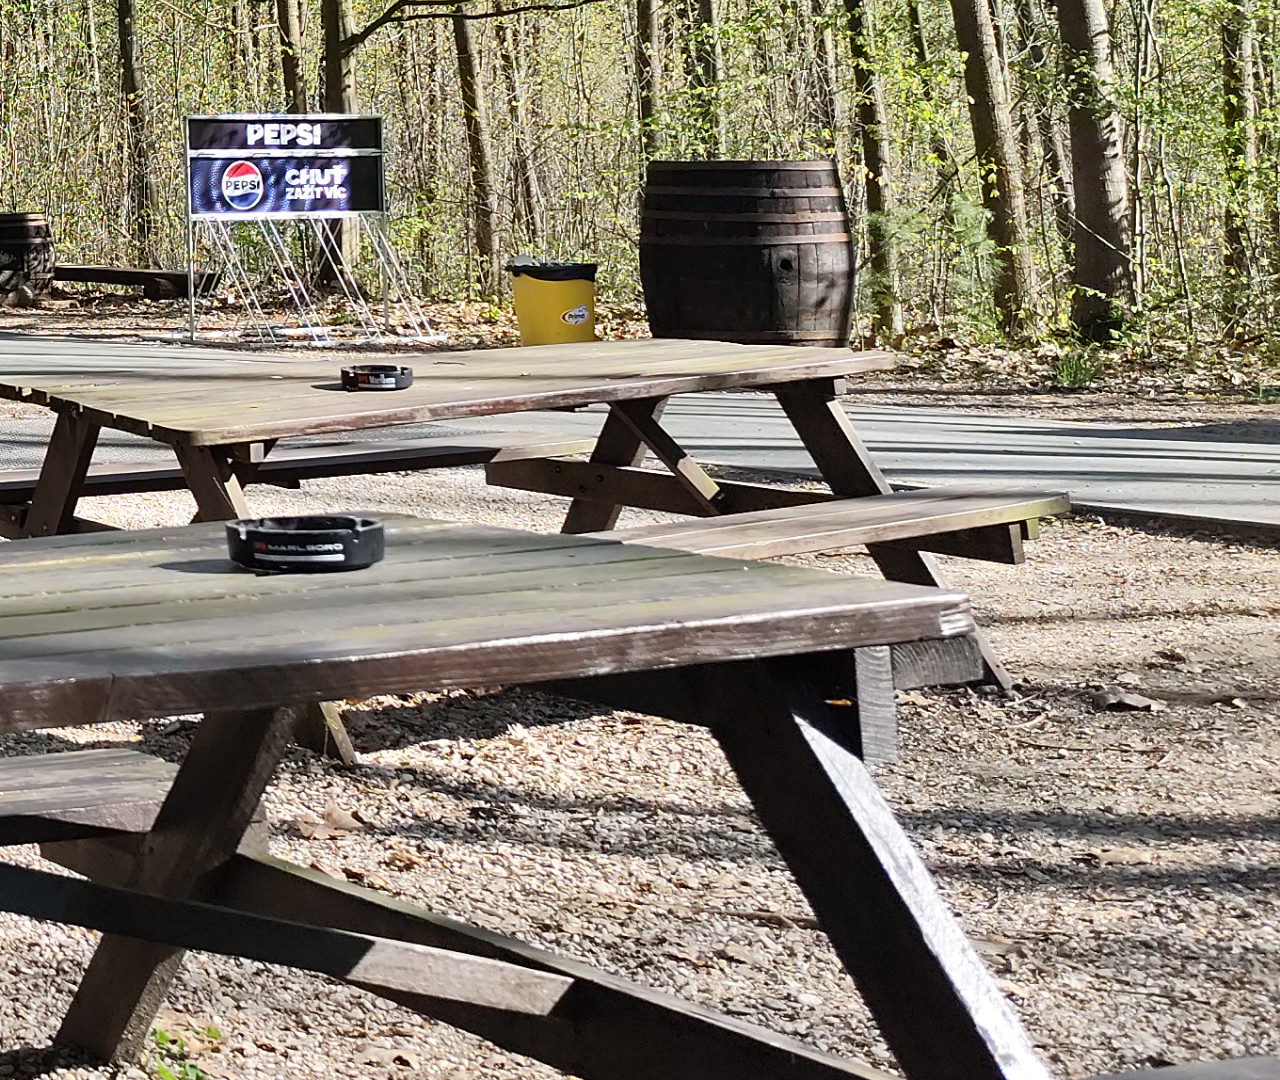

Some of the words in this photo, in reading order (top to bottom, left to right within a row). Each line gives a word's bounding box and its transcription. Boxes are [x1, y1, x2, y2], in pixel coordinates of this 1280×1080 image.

[246, 123, 322, 146] PEPSI
[285, 165, 348, 185] CHUŤ
[225, 179, 261, 190] PEPSI
[285, 184, 323, 200] ZAŽÍT
[323, 185, 347, 199] VÍC
[267, 542, 344, 552] MARLBORO
